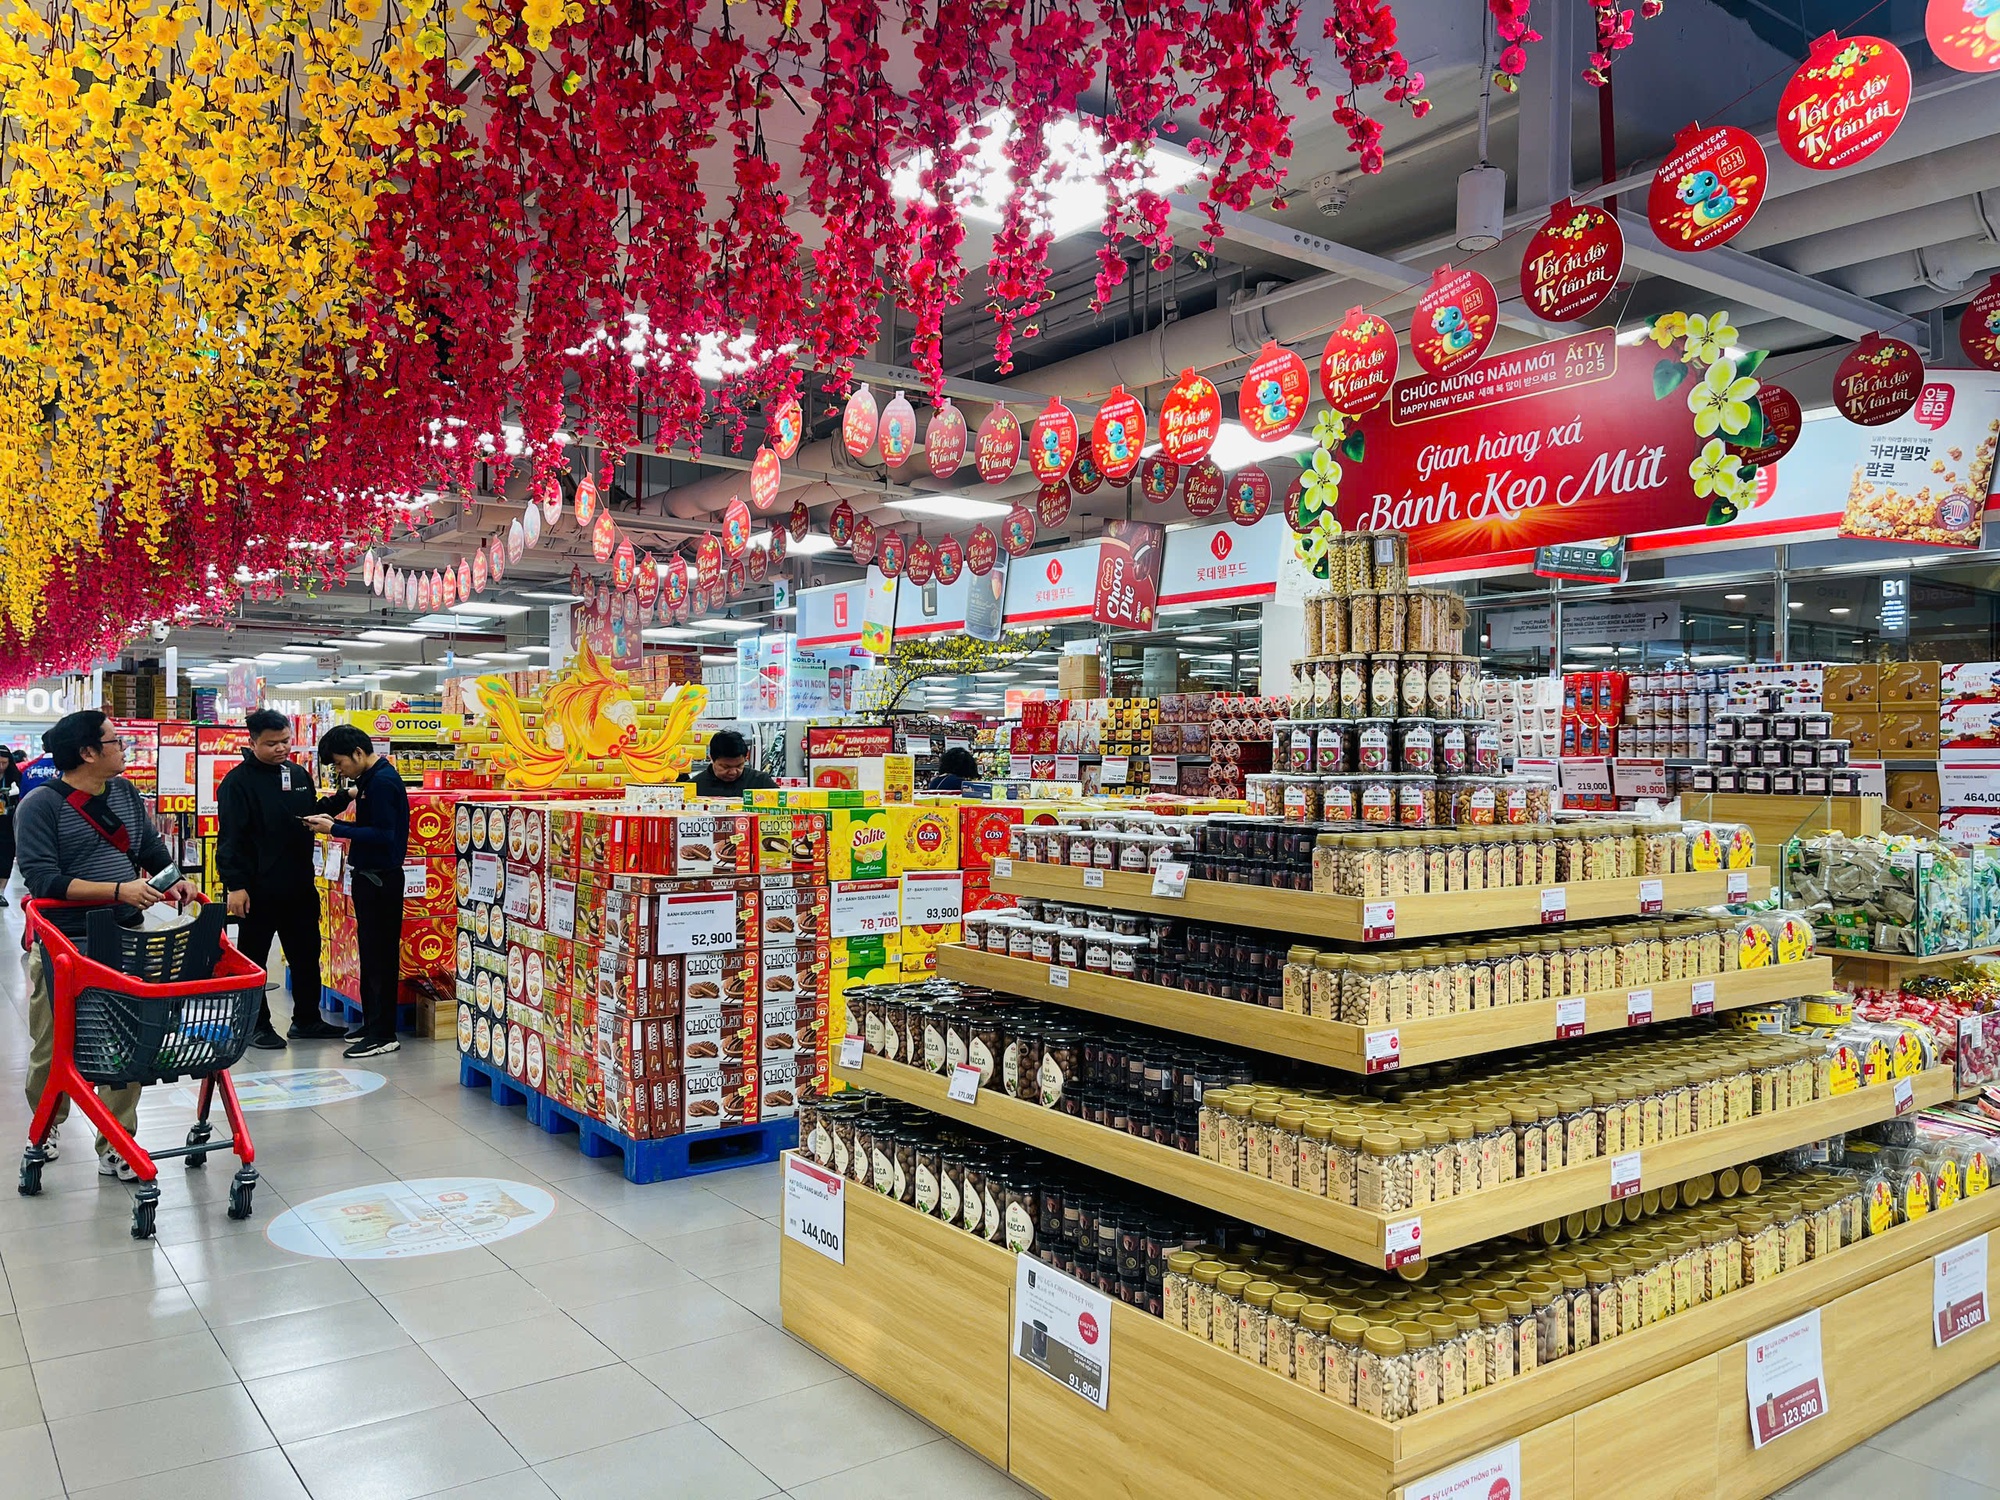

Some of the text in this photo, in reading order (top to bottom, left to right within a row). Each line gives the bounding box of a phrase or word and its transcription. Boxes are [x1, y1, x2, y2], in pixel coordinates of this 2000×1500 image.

[1788, 75, 1890, 135] Tết đủ đầy
[1799, 100, 1900, 163] Tỵ tấn tài
[1658, 129, 1727, 177] HAPPY NEW YEAR
[1836, 131, 1883, 161] LOTTE MART
[1722, 159, 1743, 174] 2025
[1700, 215, 1743, 243] LOTTE MART
[1529, 242, 1609, 285] Tết đủ đầy
[1419, 271, 1471, 306] HAPPY NEW YEAR
[1534, 266, 1613, 312] Tỵ tấn tài
[1561, 292, 1598, 314] LOTTE MART
[1447, 348, 1478, 369] LOTTE MART
[1565, 342, 1605, 363] Ất Tỵ
[1250, 353, 1292, 375] HAPPY NEW YEAR
[1326, 349, 1358, 378] Tết
[1352, 353, 1370, 371] đủ
[1565, 359, 1605, 378] 2025
[1350, 375, 1368, 391] tấn
[1368, 370, 1389, 384] tài
[1400, 379, 1438, 403] CHÚC
[1487, 361, 1521, 383] NĂM
[1524, 352, 1556, 374] MỚI
[1478, 386, 1494, 397] 새해
[1523, 371, 1557, 387] 받으세요
[1841, 372, 1878, 398] Tết
[1348, 392, 1377, 407] LOTTE MART
[1400, 391, 1475, 416] HAPPY NEW YEAR
[1886, 408, 1902, 417] MART
[1416, 414, 1584, 481] Gian hàng xá
[1870, 444, 1930, 462] 카라멜맛
[1866, 462, 1895, 478] 팝콘
[1357, 481, 1461, 531] Bánh
[1557, 445, 1668, 507] Mứt
[1197, 562, 1248, 581] 롯데웰푸드
[1107, 557, 1124, 619] Choco
[1882, 580, 1905, 597] B1
[1120, 585, 1135, 622] Pie
[396, 719, 441, 729] OTTOGI
[1577, 782, 1608, 792] 219,000
[1635, 785, 1666, 795] 89,900
[678, 819, 735, 833] CHOCOLAT
[918, 831, 938, 840] COSY
[985, 831, 1003, 840] COSY
[852, 827, 886, 847] Solite
[736, 852, 750, 863] +2
[763, 876, 789, 884] CHOCOLAT
[764, 892, 815, 907] CHOCOLAT
[861, 916, 898, 931] 78,700
[926, 907, 959, 920] 93,900
[691, 932, 733, 947] 52,900
[686, 957, 743, 972] CHOCOLAT
[764, 949, 815, 966] CHOCOLAT
[926, 957, 936, 965] COS
[685, 1015, 743, 1031] CHOCOLAT
[764, 1008, 815, 1024] CHOCOLAT
[957, 1090, 974, 1101] 171,000
[801, 1218, 839, 1252] 144,000
[1069, 1373, 1099, 1400] 91,900
[1782, 1398, 1818, 1427] 123,900
[1454, 1480, 1470, 1491] CHỌN
[1470, 1471, 1490, 1484] THÔNG
